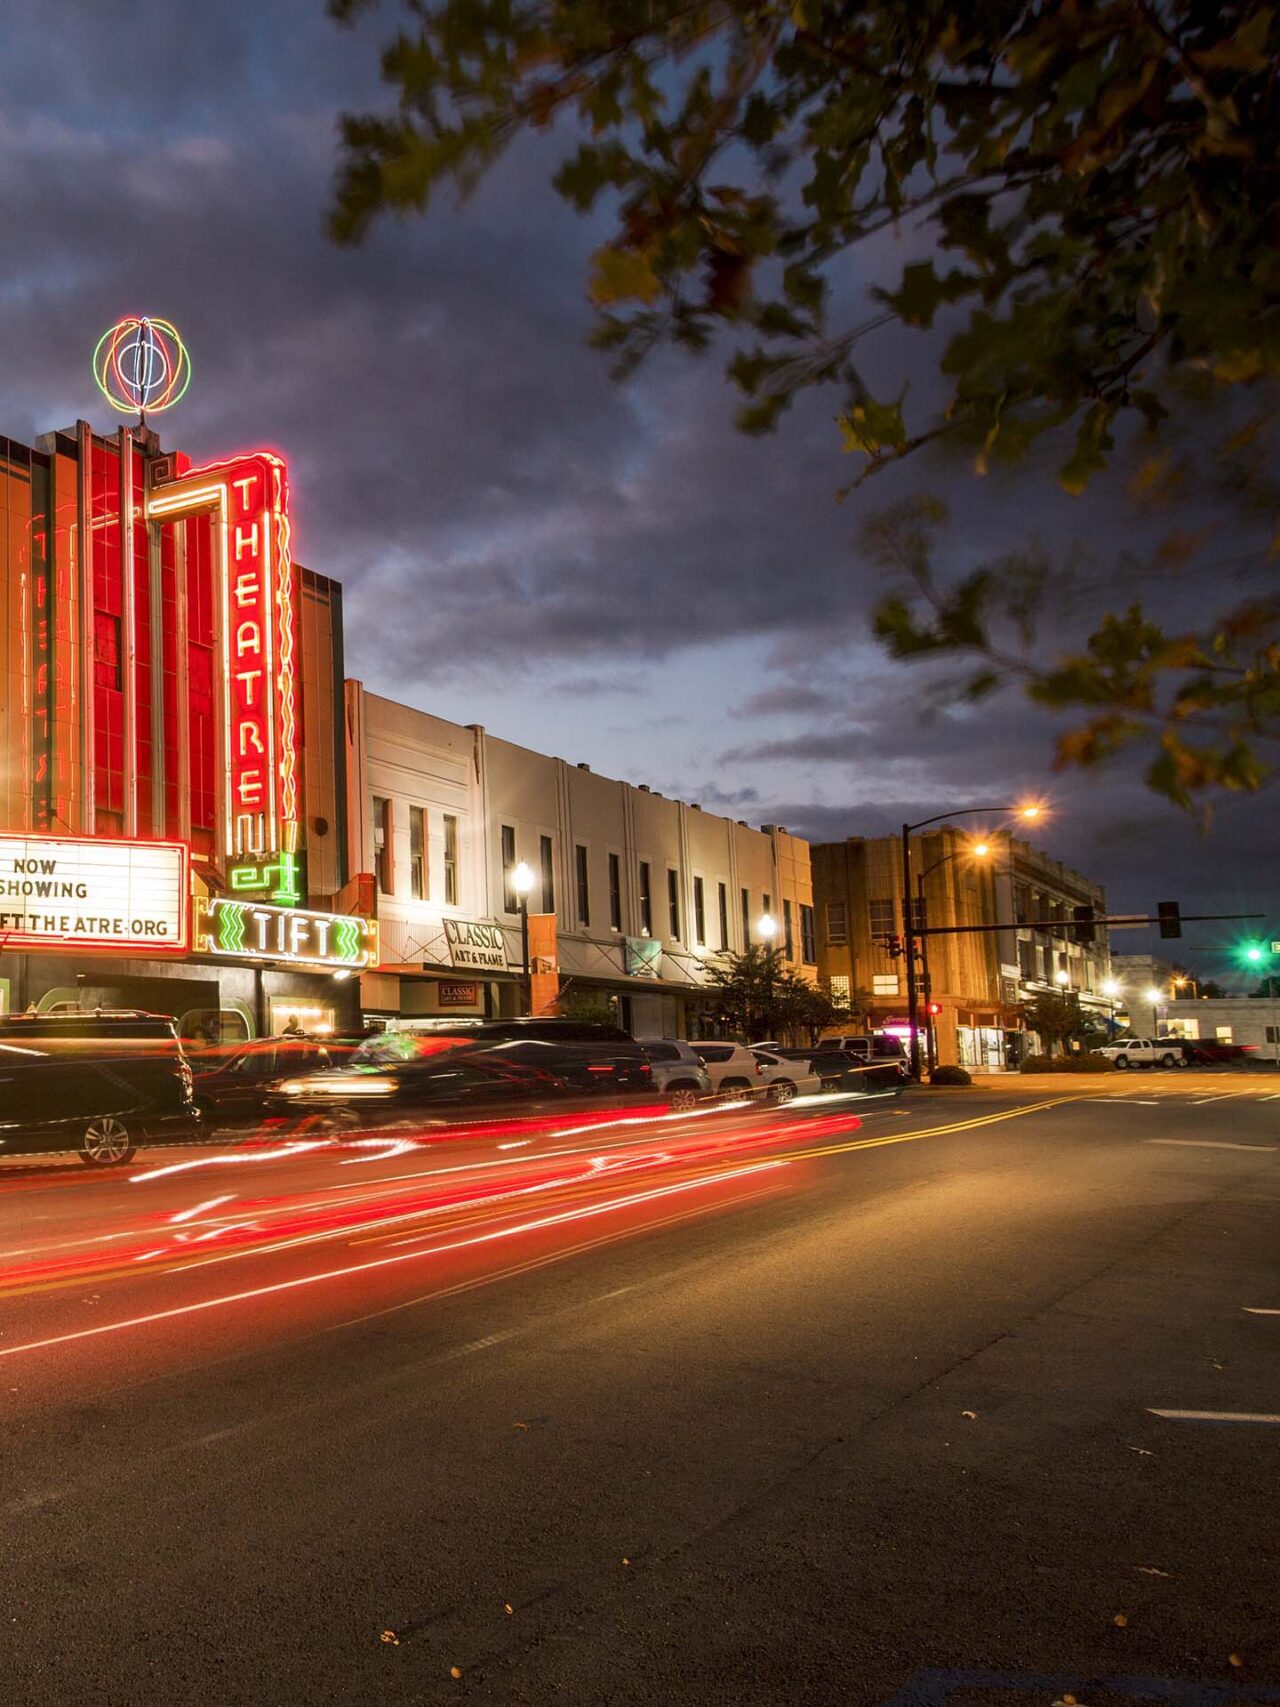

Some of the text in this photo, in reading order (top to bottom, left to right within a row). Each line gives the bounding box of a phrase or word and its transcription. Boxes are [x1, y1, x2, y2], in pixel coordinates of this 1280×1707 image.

[232, 477, 264, 805] THEATRE
[14, 859, 56, 875] NOW
[255, 911, 330, 956] TIFT
[445, 921, 504, 950] CLASSIC
[455, 950, 503, 966] ART & FRAME
